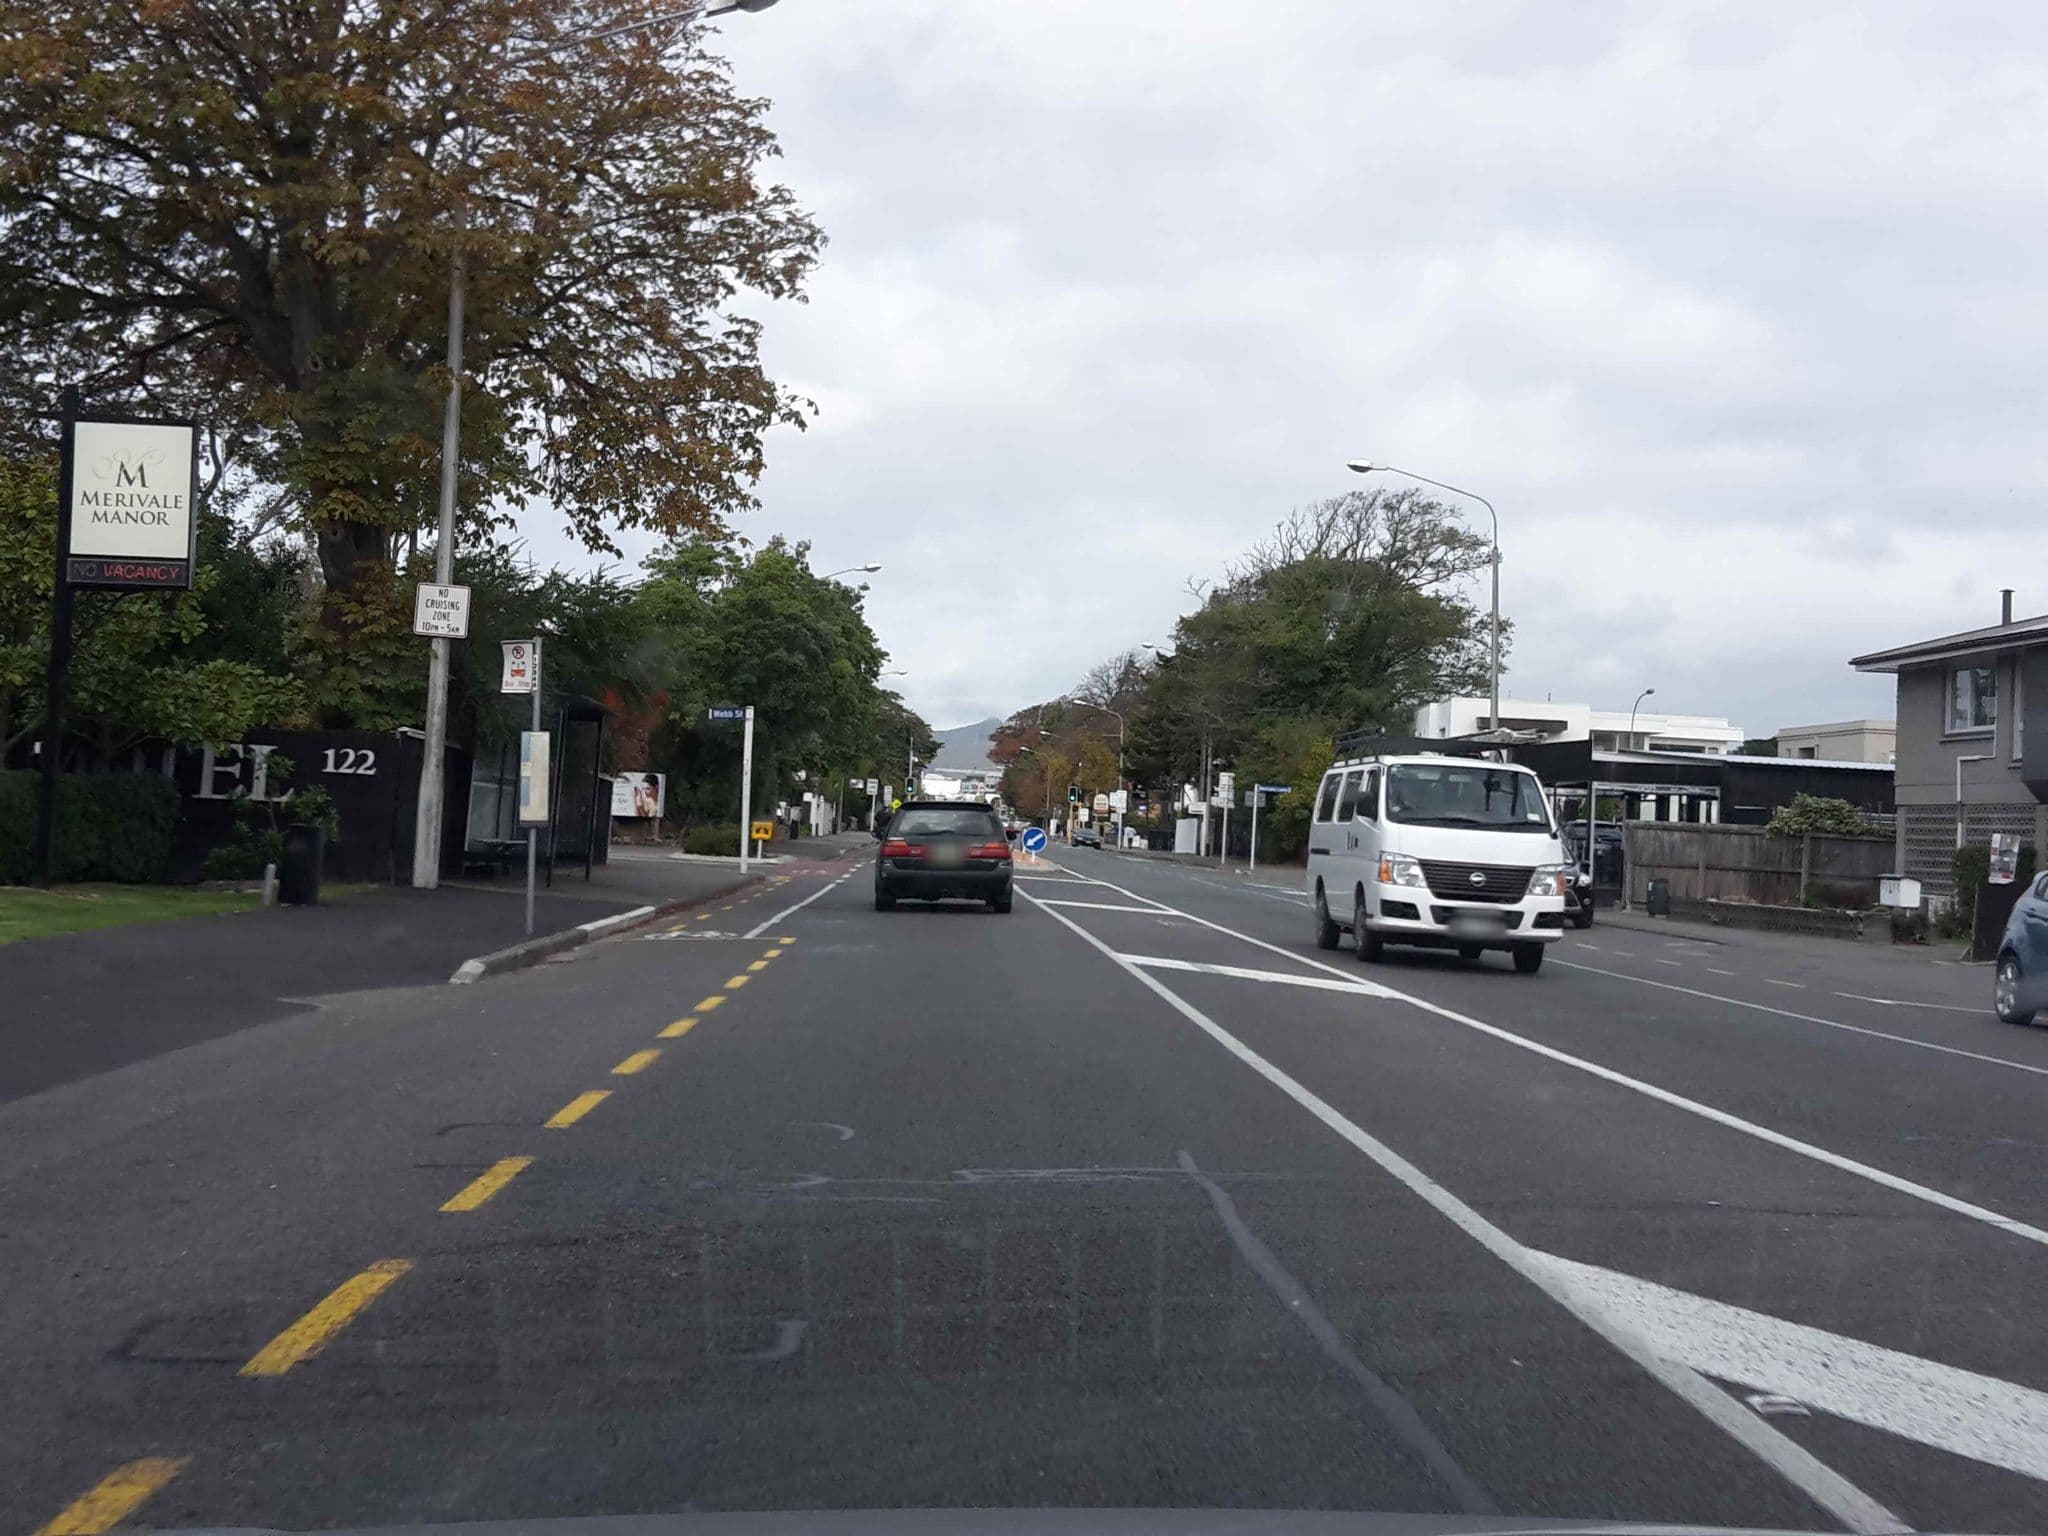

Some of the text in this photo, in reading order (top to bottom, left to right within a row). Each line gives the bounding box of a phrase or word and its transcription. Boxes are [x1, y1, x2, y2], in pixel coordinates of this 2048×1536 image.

[115, 461, 149, 488] M
[80, 489, 183, 510] MERIVALE
[91, 510, 170, 526] MANOR
[73, 563, 179, 580] NO VACANCY
[438, 588, 449, 598] NO
[425, 598, 460, 611] CRUISING
[432, 611, 451, 622] ZONE
[734, 710, 744, 718] St
[322, 748, 376, 775] 122
